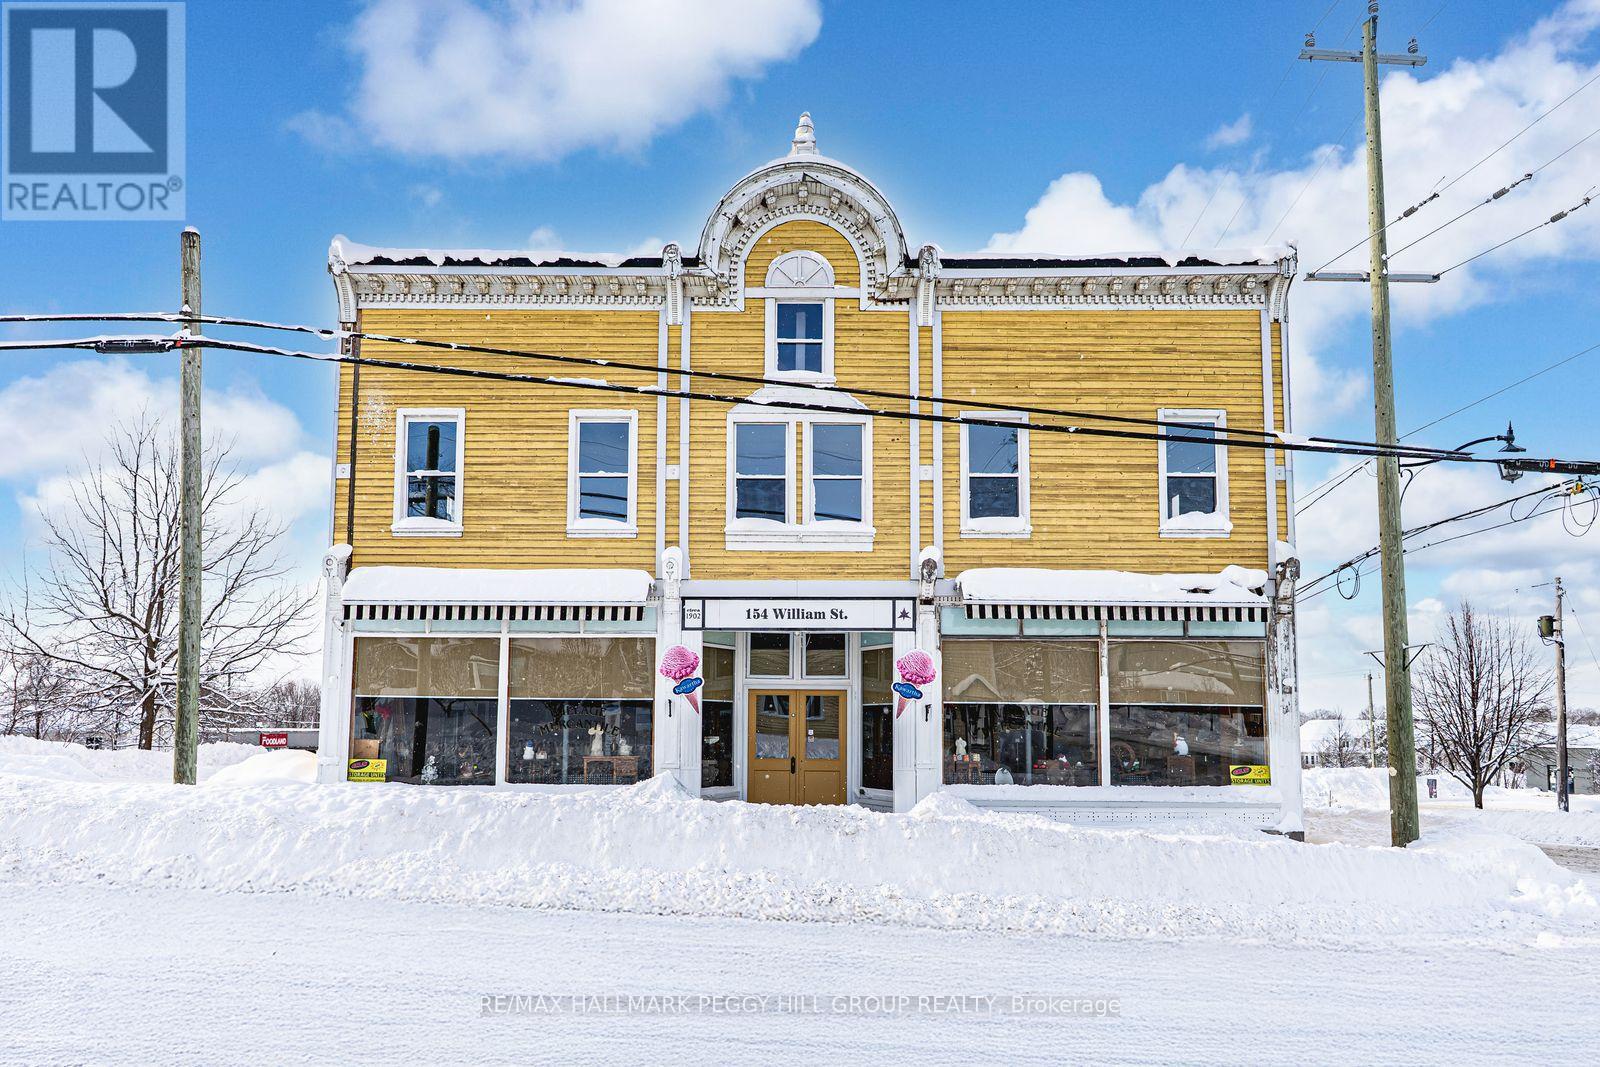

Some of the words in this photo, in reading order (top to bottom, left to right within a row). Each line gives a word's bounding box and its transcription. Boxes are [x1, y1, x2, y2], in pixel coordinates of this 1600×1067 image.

[746, 608, 768, 620] 154
[773, 608, 826, 620] William
[830, 608, 848, 620] St.
[674, 679, 701, 694] Kawartha
[894, 683, 921, 697] Kawartha
[262, 736, 286, 745] FOODLAND
